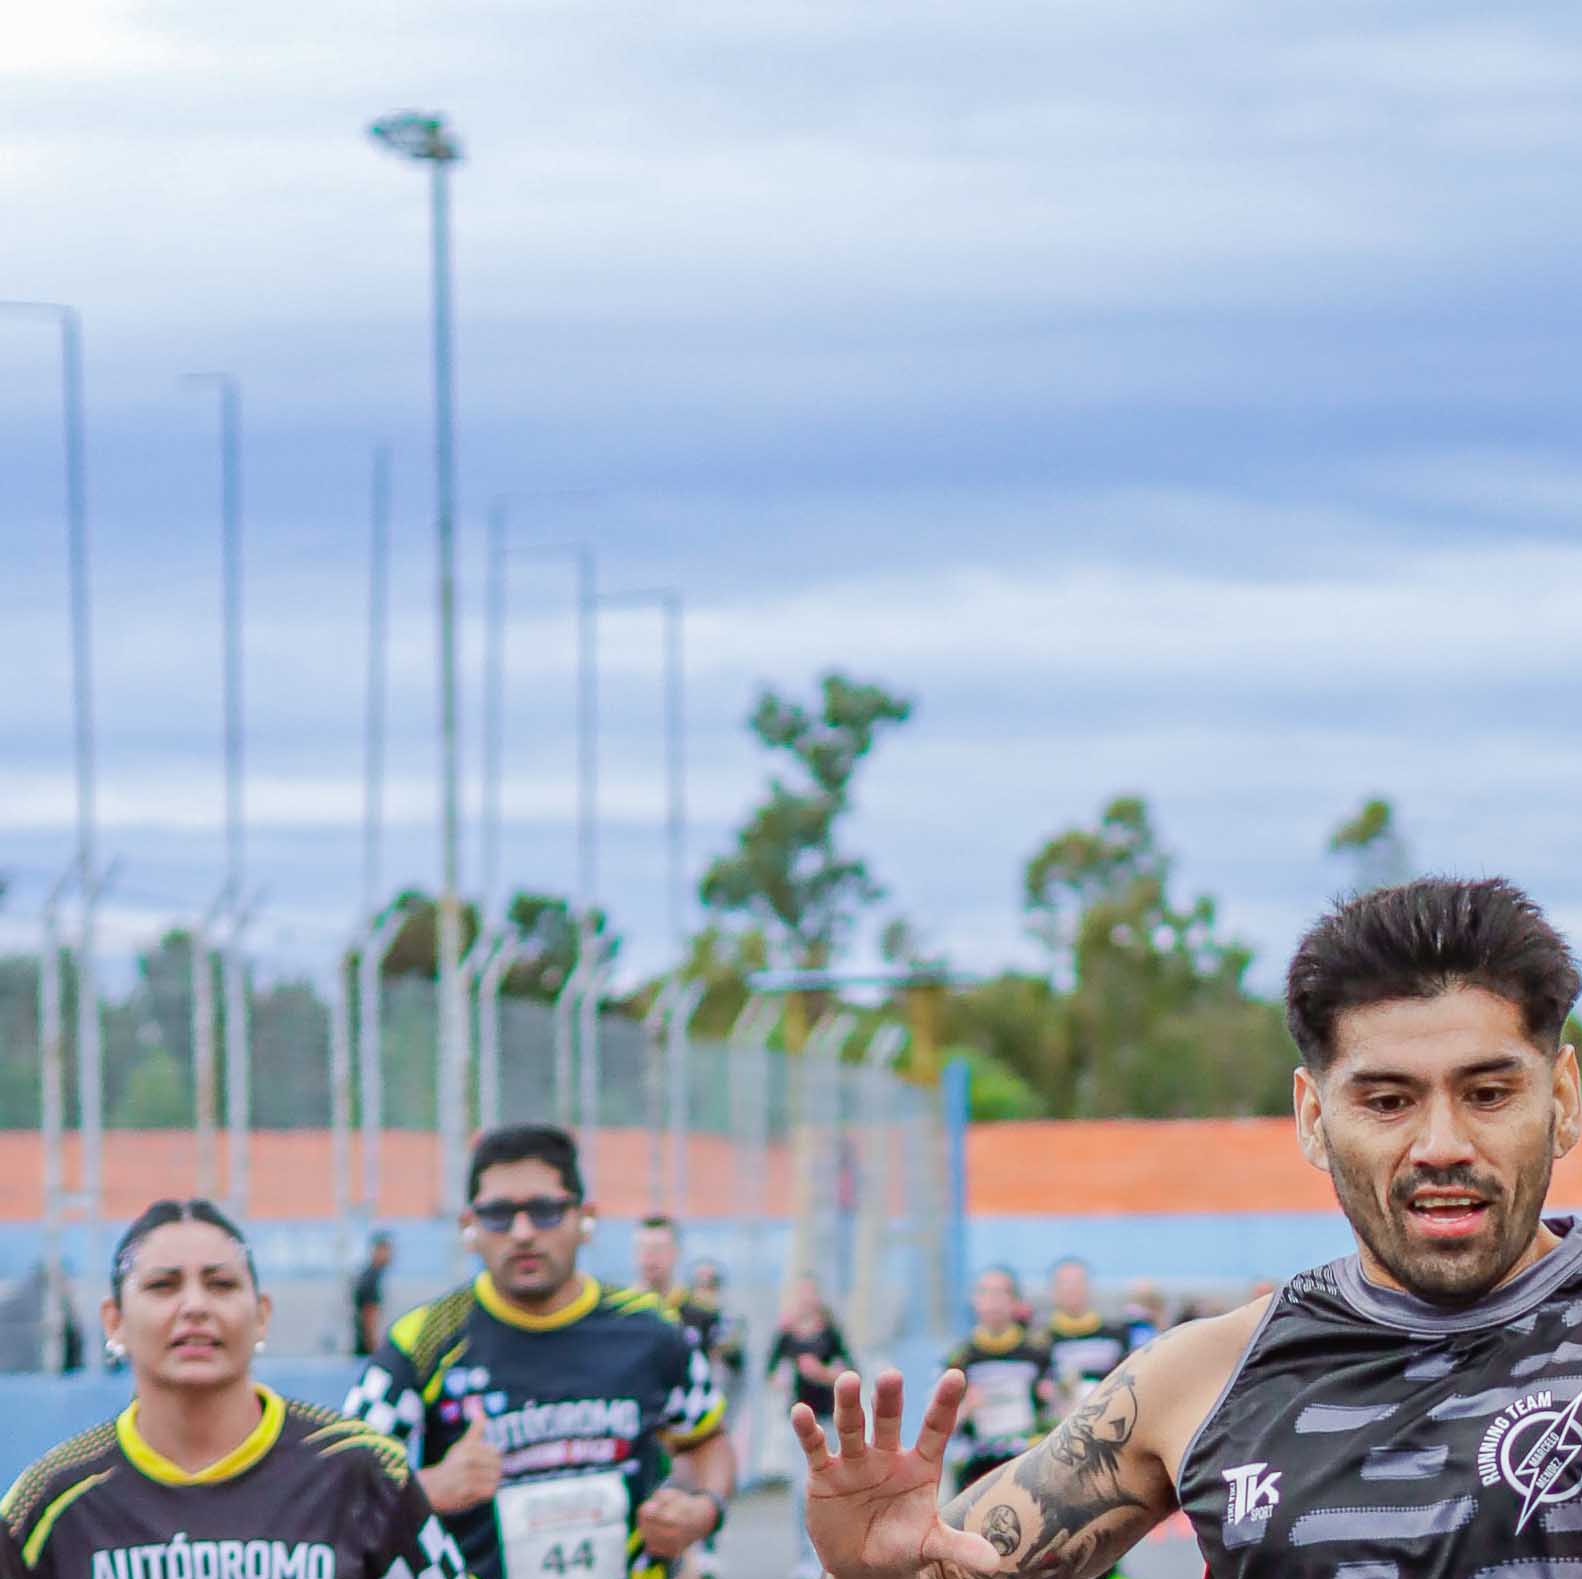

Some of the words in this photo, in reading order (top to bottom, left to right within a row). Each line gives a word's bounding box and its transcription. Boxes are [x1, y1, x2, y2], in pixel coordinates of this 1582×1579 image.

[1477, 1415, 1511, 1488] RUNNING
[1505, 1390, 1552, 1420] TEAM
[1528, 1431, 1560, 1467] MARCELO
[1535, 1456, 1563, 1489] MENDEZ
[1221, 1462, 1283, 1525] TK
[542, 1538, 596, 1575] 44
